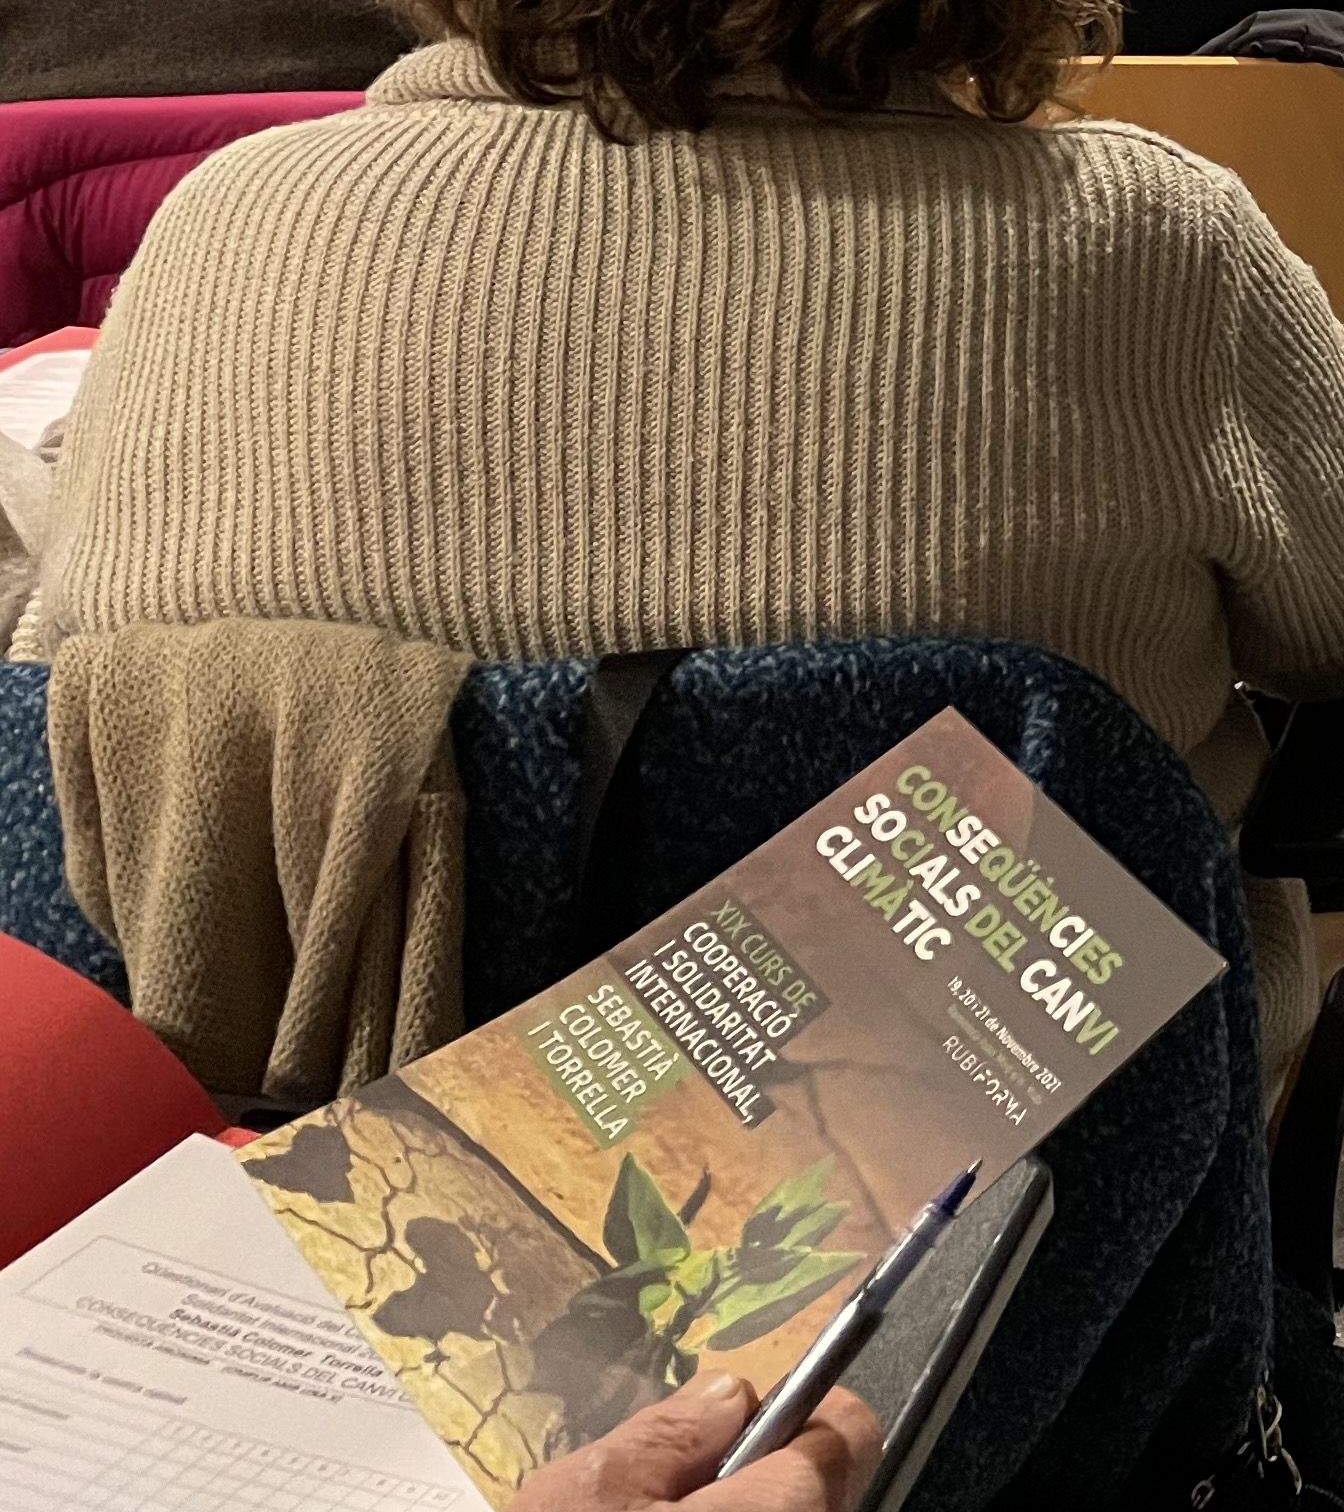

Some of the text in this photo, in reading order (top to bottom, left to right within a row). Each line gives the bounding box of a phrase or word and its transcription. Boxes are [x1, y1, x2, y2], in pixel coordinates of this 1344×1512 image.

[815, 825, 951, 960] CLIMÀTIC
[854, 793, 1120, 1055] SOCIALS DEL CANVI
[896, 765, 1123, 985] CONSEQÜÈNCIES
[654, 939, 776, 1070] I SOLIDARITAT
[684, 921, 798, 1038] COOPERACIÓ
[711, 900, 818, 1008] XIX CURS DE
[527, 1020, 629, 1140] I TORRELLA
[559, 1004, 647, 1103] COLOMER
[587, 984, 679, 1081] SEBASTIÀ
[625, 959, 760, 1124] INTERNACIONAL,
[947, 975, 963, 996] 19,
[958, 987, 977, 1006] 20
[975, 1005, 991, 1021] 21
[984, 1017, 1000, 1032] de
[995, 1025, 1040, 1073] Novembre
[1035, 1067, 1062, 1094] 2021
[224, 1344, 303, 1374] SOCIALS
[301, 1366, 337, 1384] DEL
[341, 1377, 400, 1397] CANVI
[242, 1331, 313, 1357] Colomer
[321, 1353, 384, 1378] Torrella
[316, 1320, 346, 1333] del
